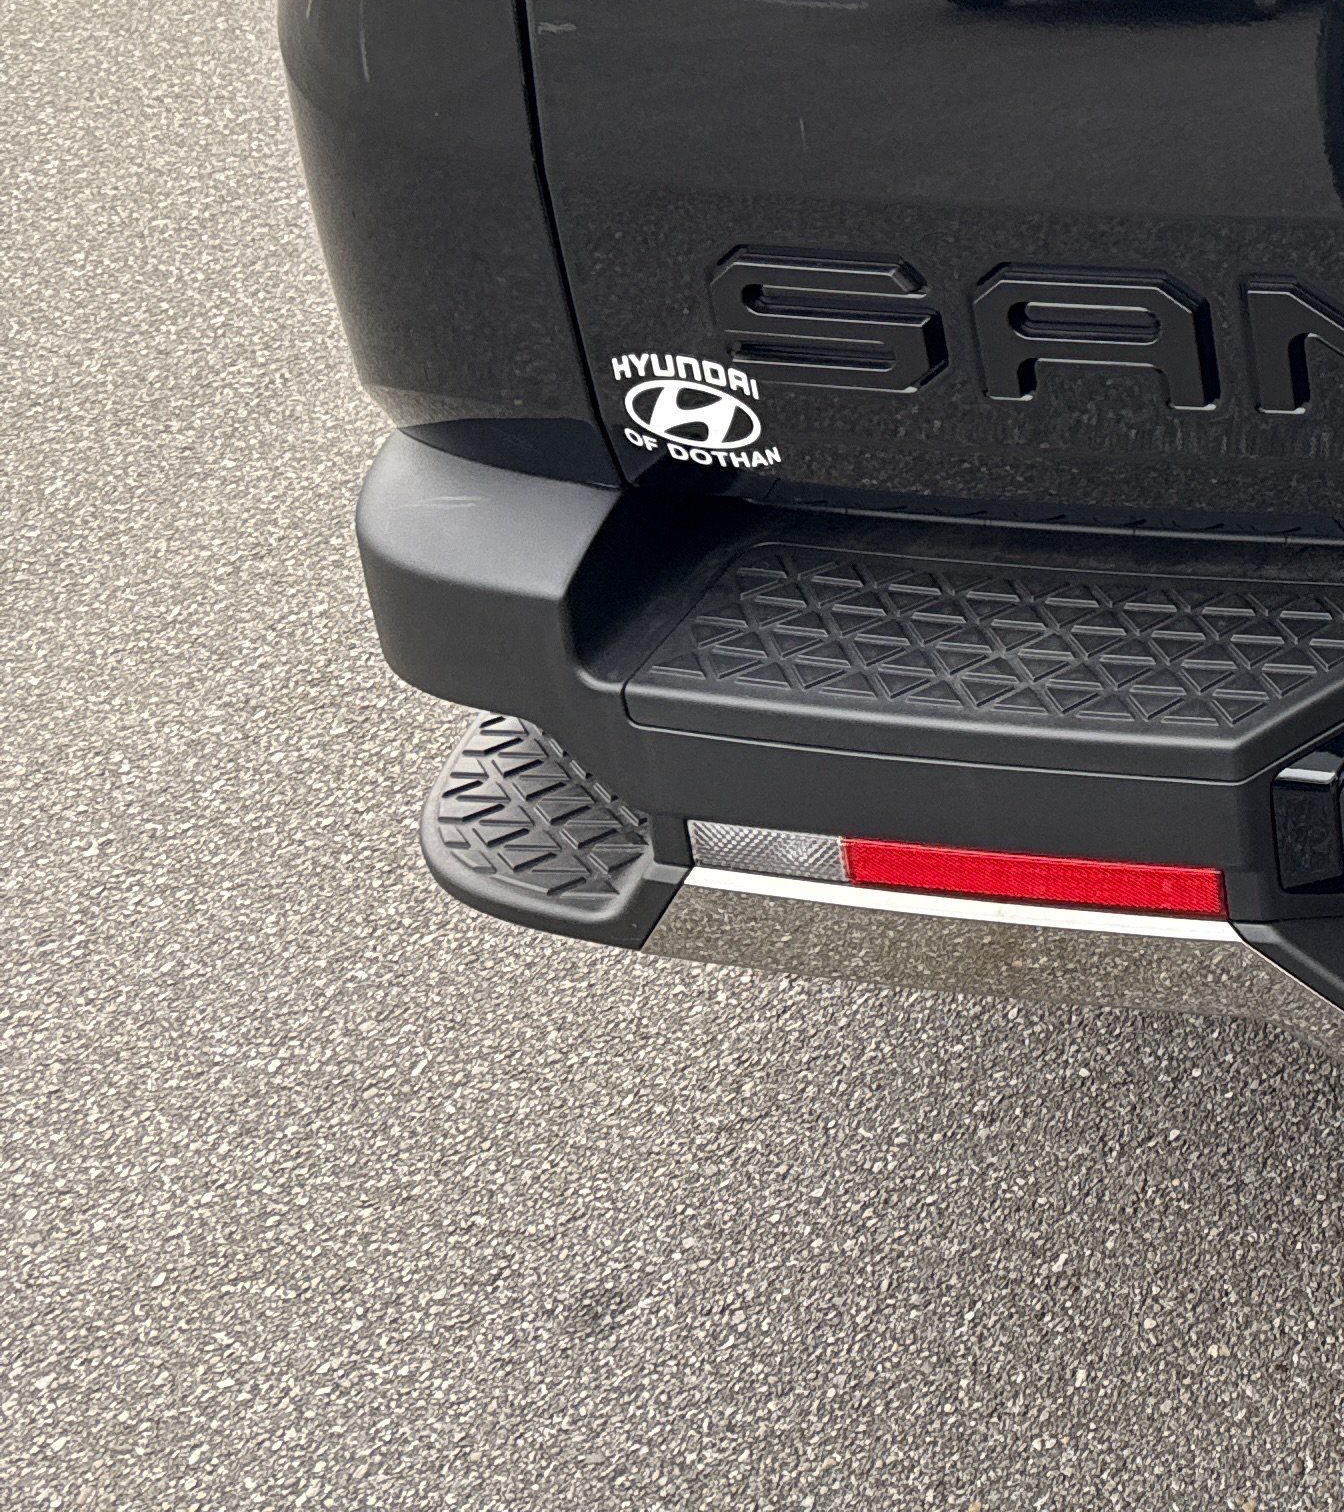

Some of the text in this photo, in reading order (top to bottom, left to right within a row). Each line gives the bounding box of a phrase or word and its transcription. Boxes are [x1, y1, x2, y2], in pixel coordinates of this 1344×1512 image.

[611, 353, 760, 400] HYUNDAI
[624, 427, 782, 468] OF DOTHAN
